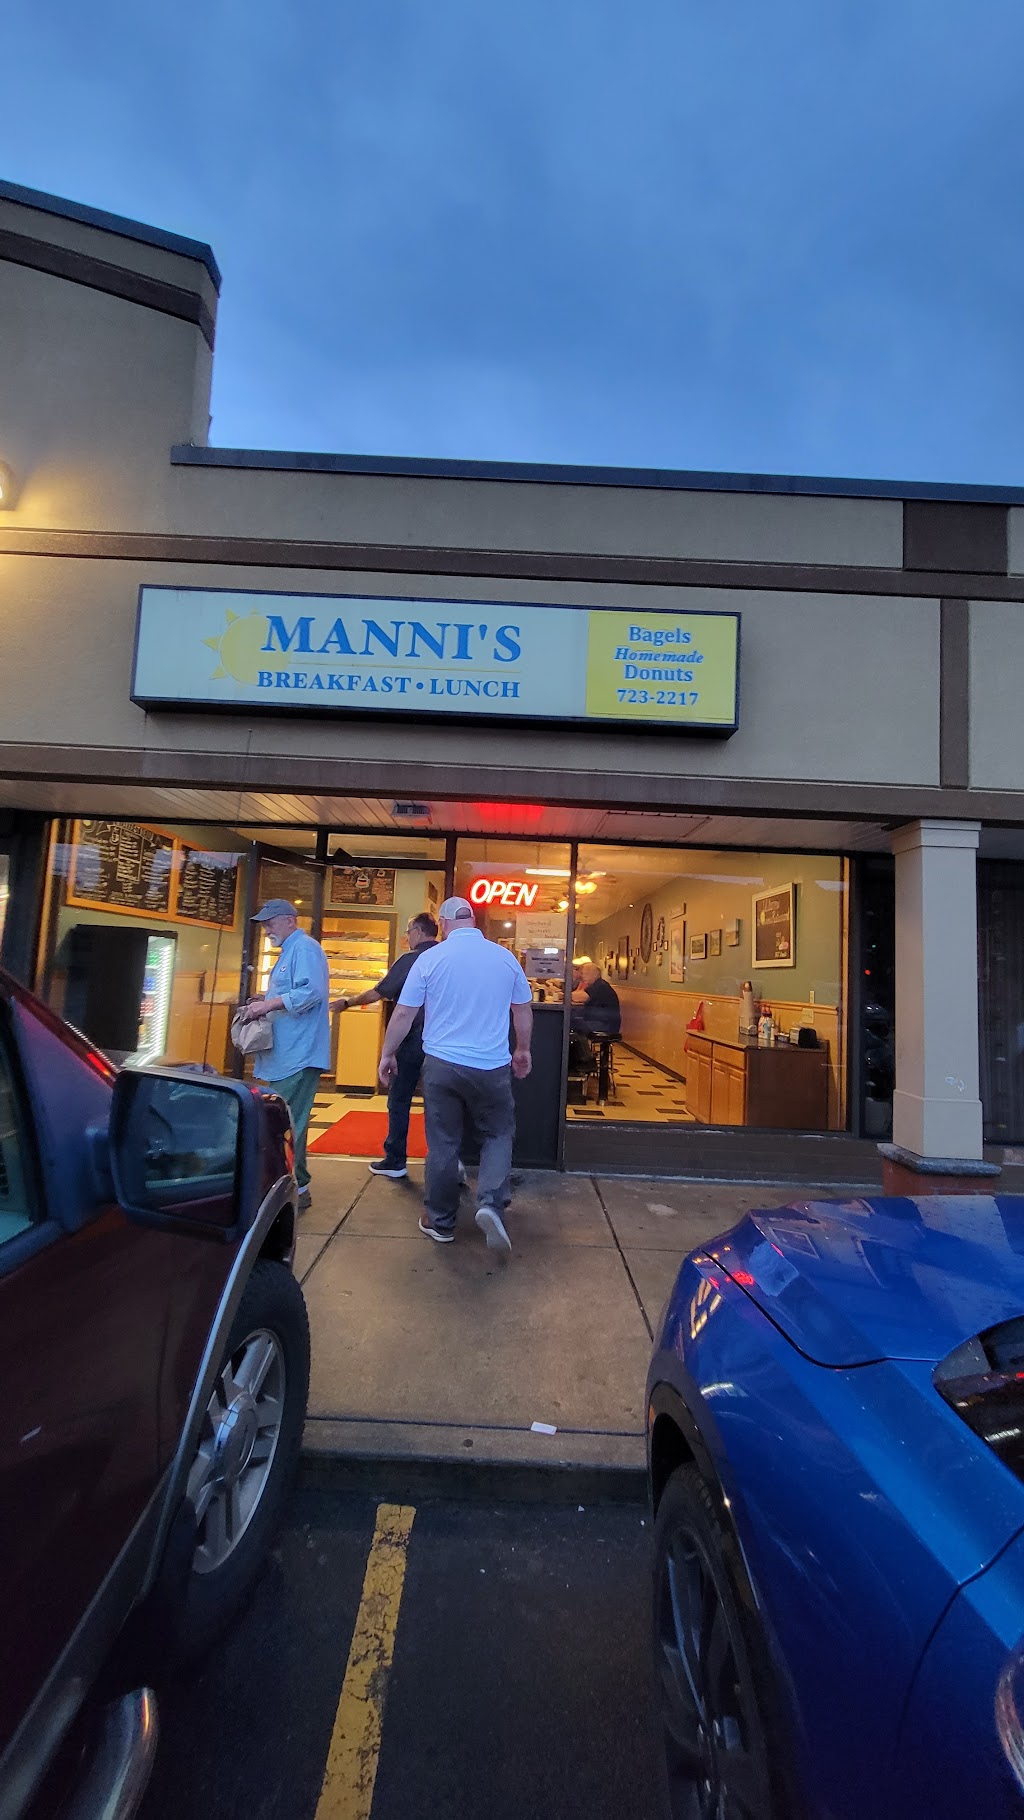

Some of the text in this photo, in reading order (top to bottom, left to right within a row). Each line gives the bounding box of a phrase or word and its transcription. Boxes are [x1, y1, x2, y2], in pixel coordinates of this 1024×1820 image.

[261, 615, 521, 662] MANNI'S
[629, 626, 691, 646] Bagels
[614, 648, 704, 663] Homemade
[624, 665, 693, 682] Donuts
[257, 671, 521, 698] BREAKFAST LUNCH
[617, 689, 698, 706] 723-2217
[470, 879, 539, 907] OPEN
